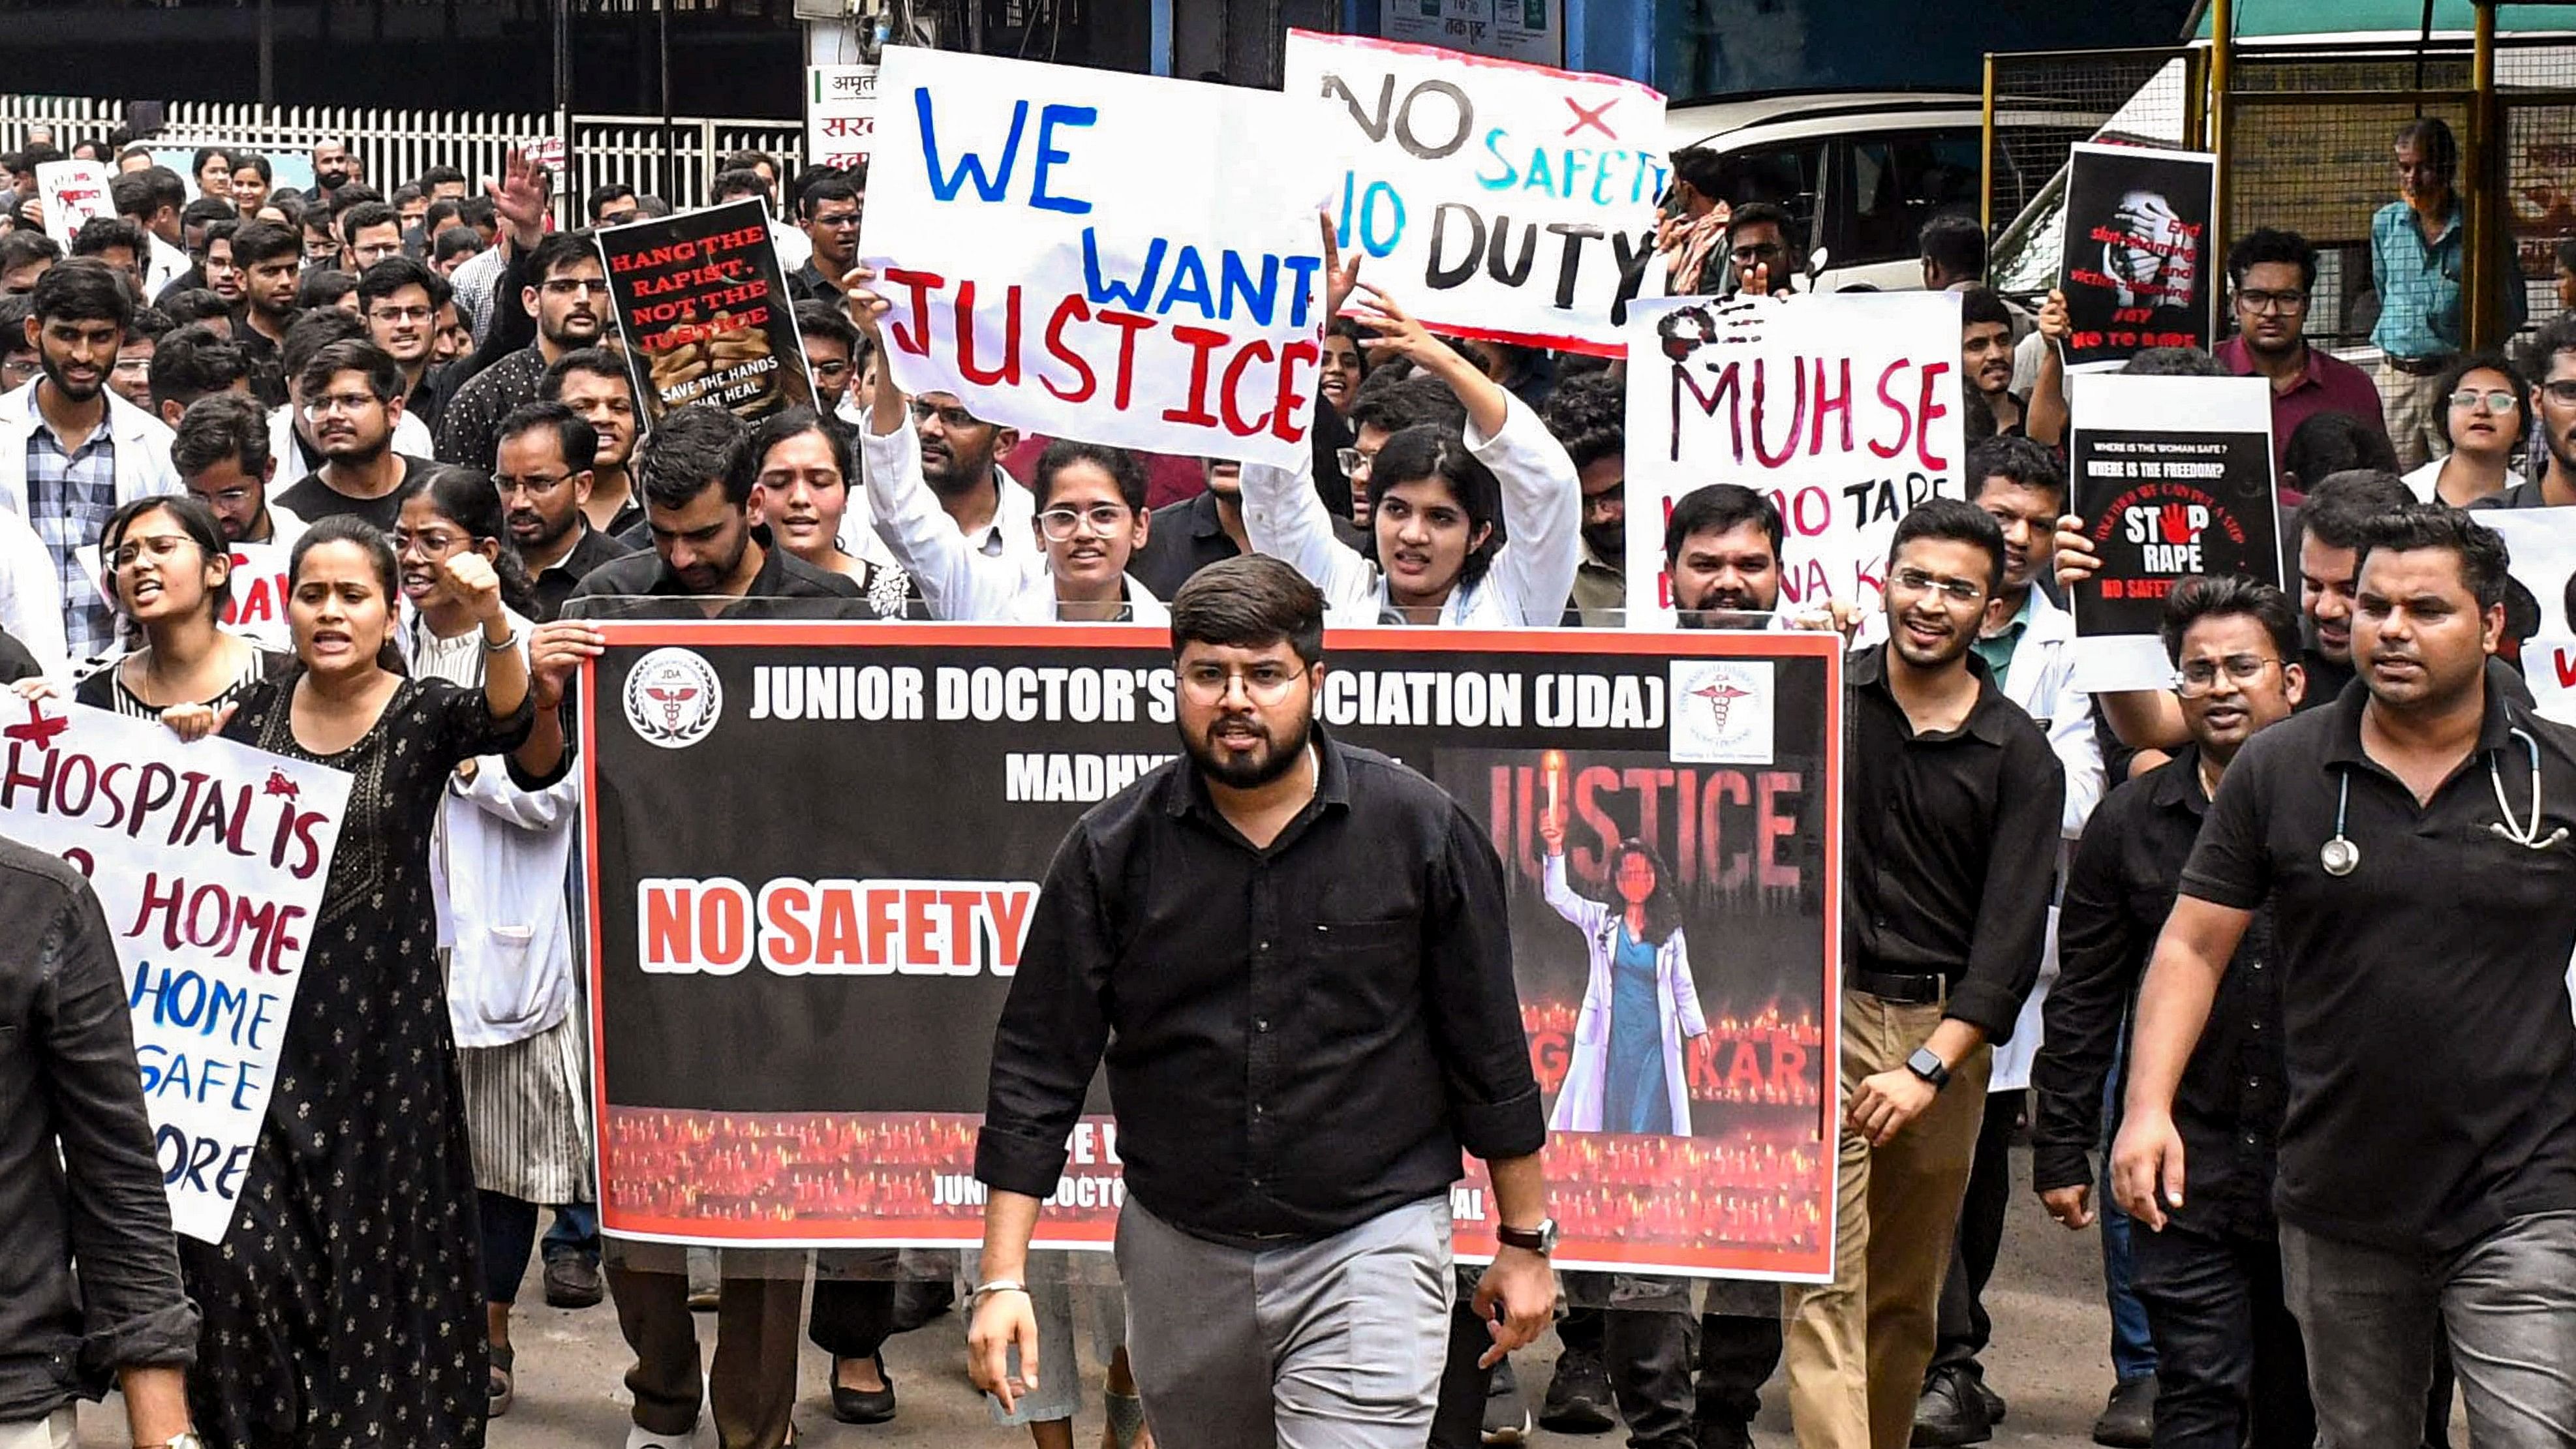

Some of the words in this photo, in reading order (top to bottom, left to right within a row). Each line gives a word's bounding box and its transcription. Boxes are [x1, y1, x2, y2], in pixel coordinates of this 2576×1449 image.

[1321, 74, 1473, 159] NO
[915, 87, 1097, 214] WE
[611, 242, 697, 273] HANG
[698, 226, 765, 255] THE
[2168, 219, 2202, 237] End
[1082, 226, 1321, 326] WANT
[1426, 202, 1657, 327] DUTY
[2159, 264, 2193, 280] and
[632, 298, 696, 325] NOT
[701, 280, 769, 310] THE
[642, 307, 769, 352] JUSTICE
[2108, 332, 2137, 346] TO
[884, 267, 1319, 442] JUSTICE
[660, 380, 697, 402] SAVE
[698, 371, 726, 391] THE
[729, 356, 778, 382] HANDS
[724, 382, 761, 403] HEAL
[2087, 461, 2124, 477] WHERE
[2126, 461, 2138, 477] IS
[2140, 462, 2162, 477] THE
[2164, 463, 2225, 478] FREEDOM?
[2127, 443, 2136, 452] IS
[2138, 443, 2156, 453] THE
[2157, 444, 2196, 453] WOMAN
[2143, 545, 2204, 573] RAPE
[2101, 579, 2123, 598] NO
[662, 669, 681, 679] JDA
[749, 665, 924, 721] JUNIOR
[935, 666, 1175, 723] DOCTOR'S
[1535, 674, 1664, 729] (JDA)
[270, 800, 330, 879] IS
[1490, 764, 1802, 892] JUSTICE
[122, 872, 307, 974] HOME
[645, 885, 746, 967] NO
[765, 886, 1034, 968] SAFETY
[131, 961, 279, 1050] HOME
[135, 1045, 263, 1110] SAFE
